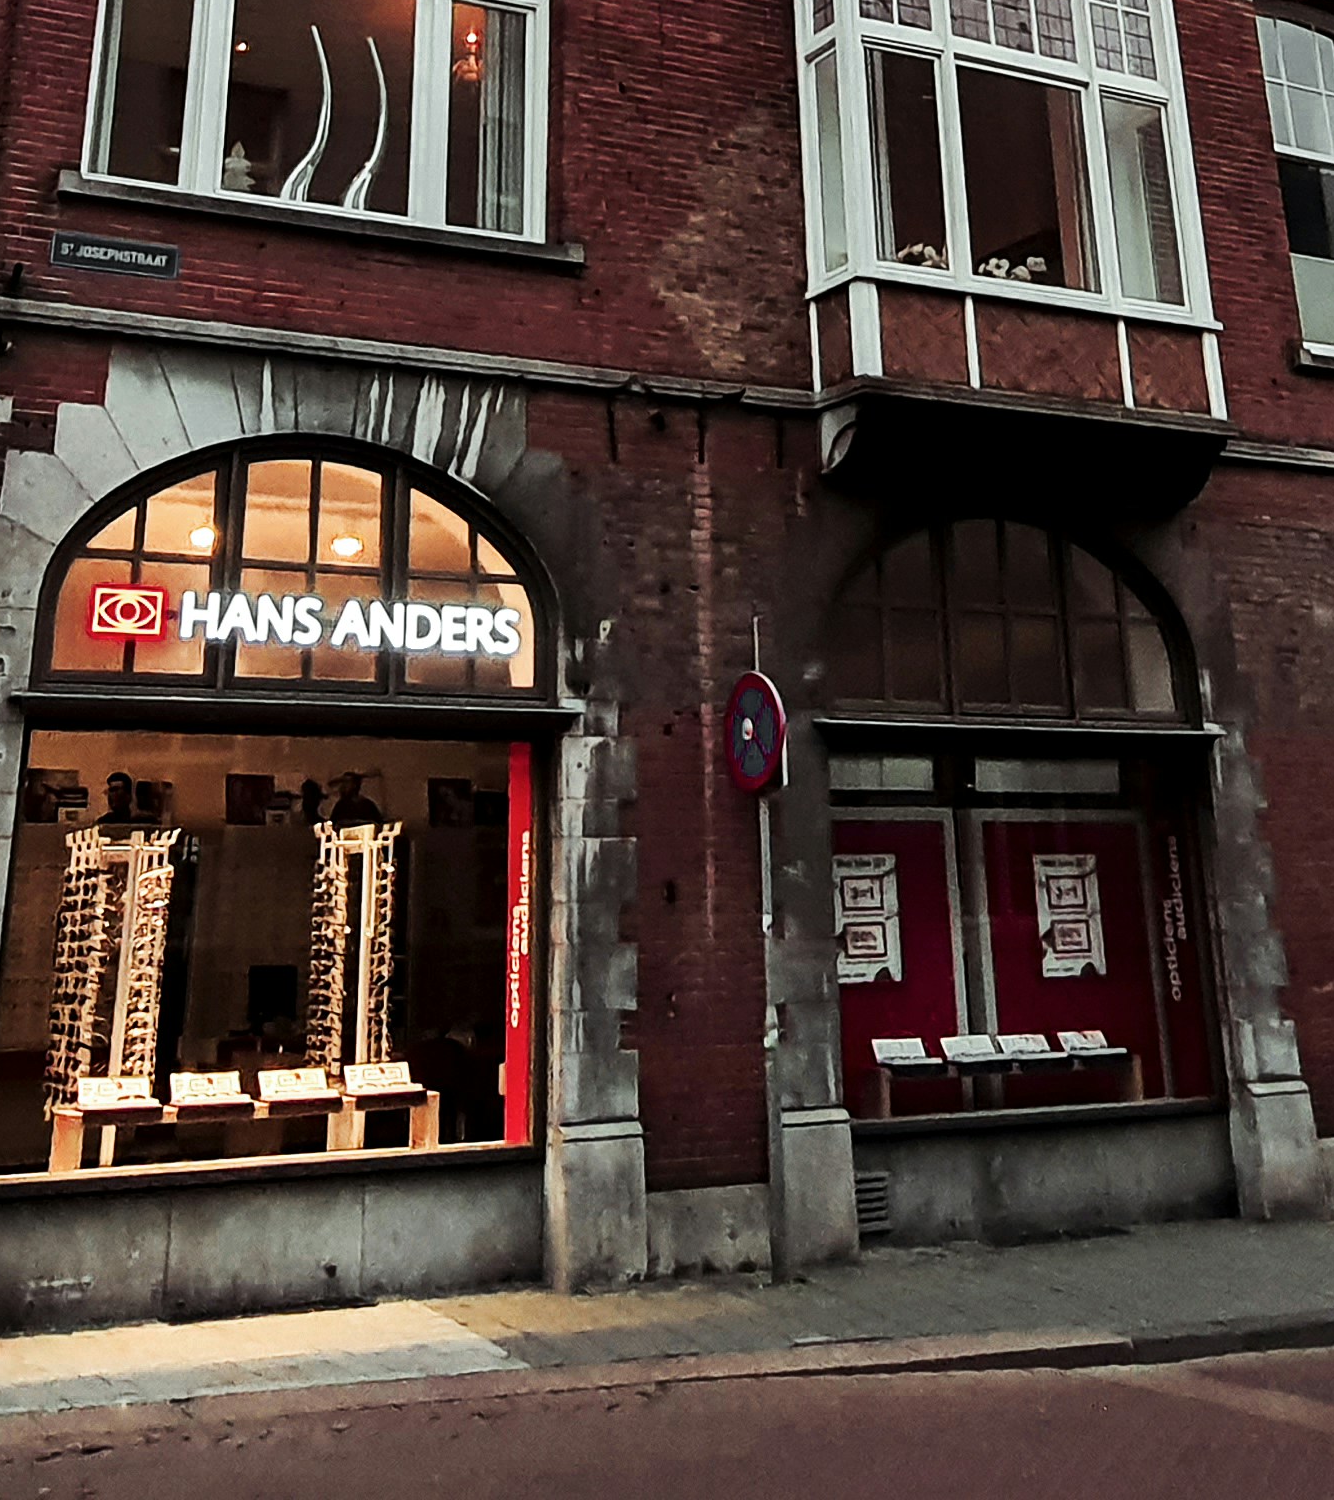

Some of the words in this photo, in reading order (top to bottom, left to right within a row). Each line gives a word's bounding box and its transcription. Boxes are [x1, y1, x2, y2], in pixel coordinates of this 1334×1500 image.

[75, 245, 168, 267] JOSEPHSTRAAT
[178, 590, 324, 646] HANS
[330, 601, 522, 656] ANDERS
[518, 830, 530, 956] audiciens
[509, 905, 521, 1029] opticiens
